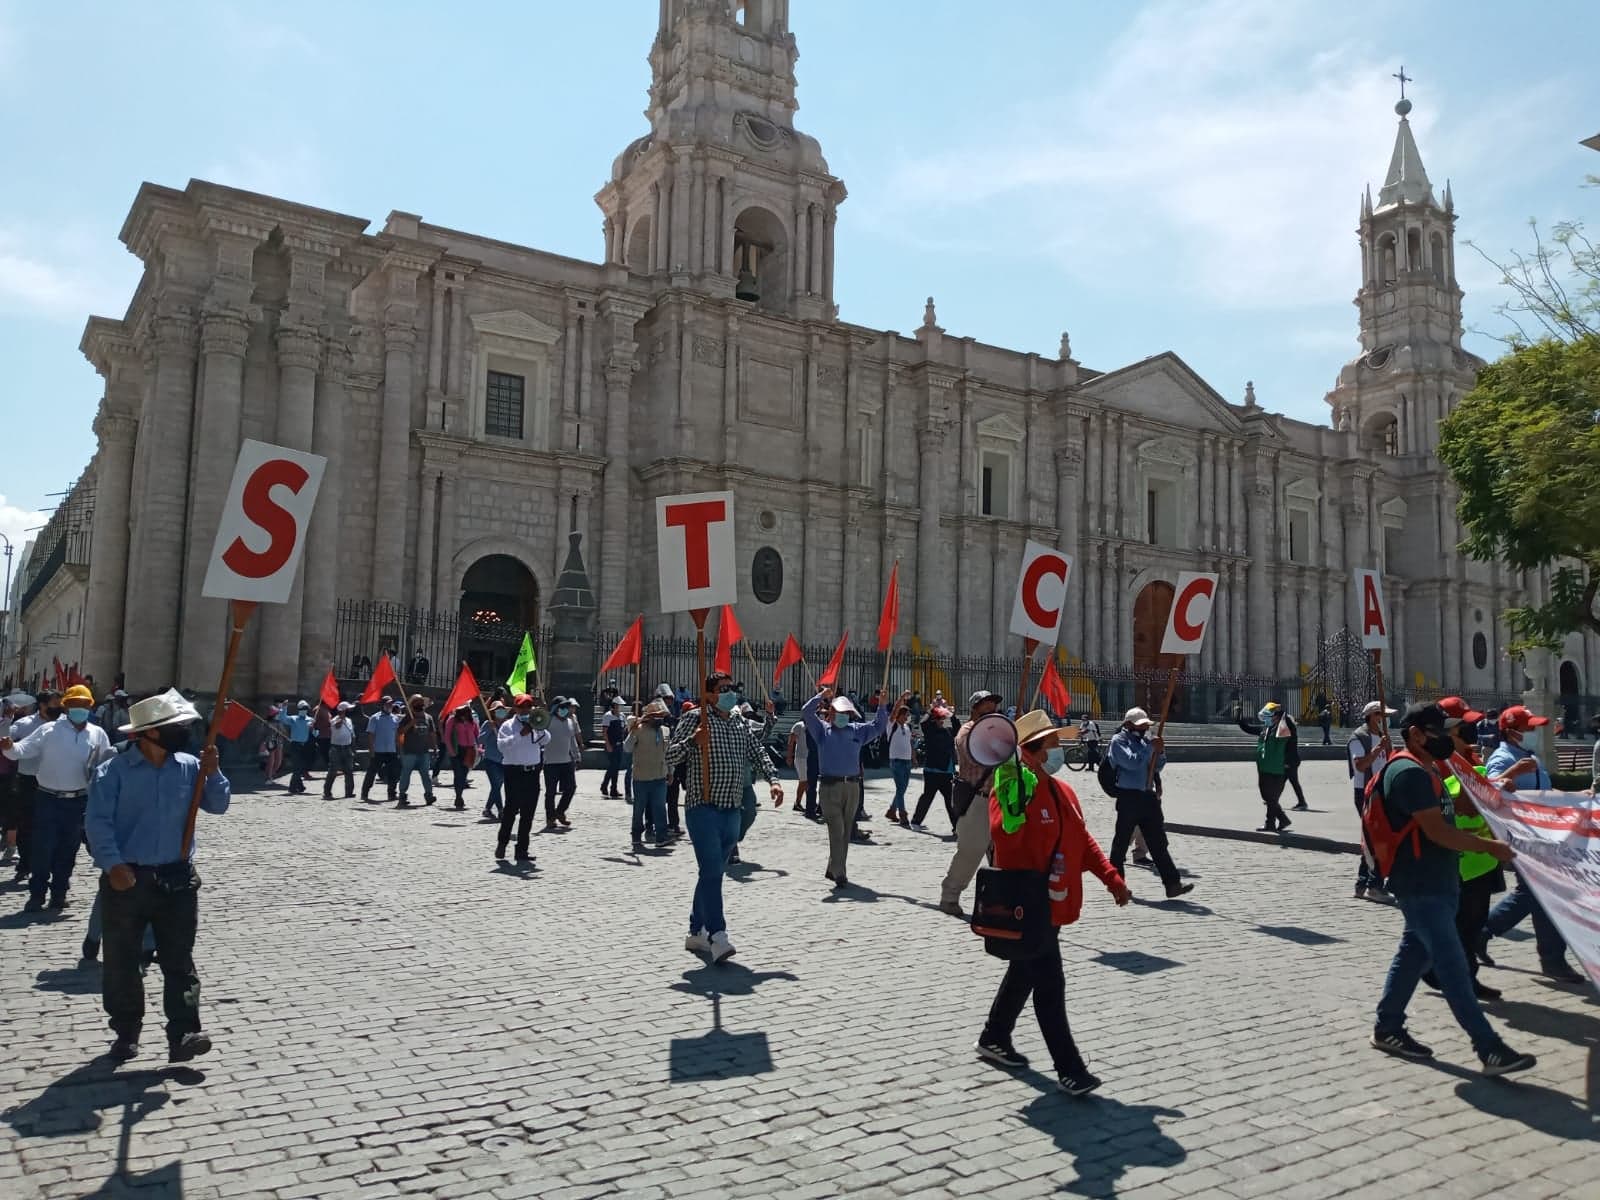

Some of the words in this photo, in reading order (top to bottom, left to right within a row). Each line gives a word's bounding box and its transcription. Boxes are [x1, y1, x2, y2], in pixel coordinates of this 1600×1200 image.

[222, 459, 309, 578] S
[665, 500, 726, 590] T
[1021, 554, 1067, 629] C
[1173, 578, 1214, 642] C
[1363, 574, 1386, 636] A
